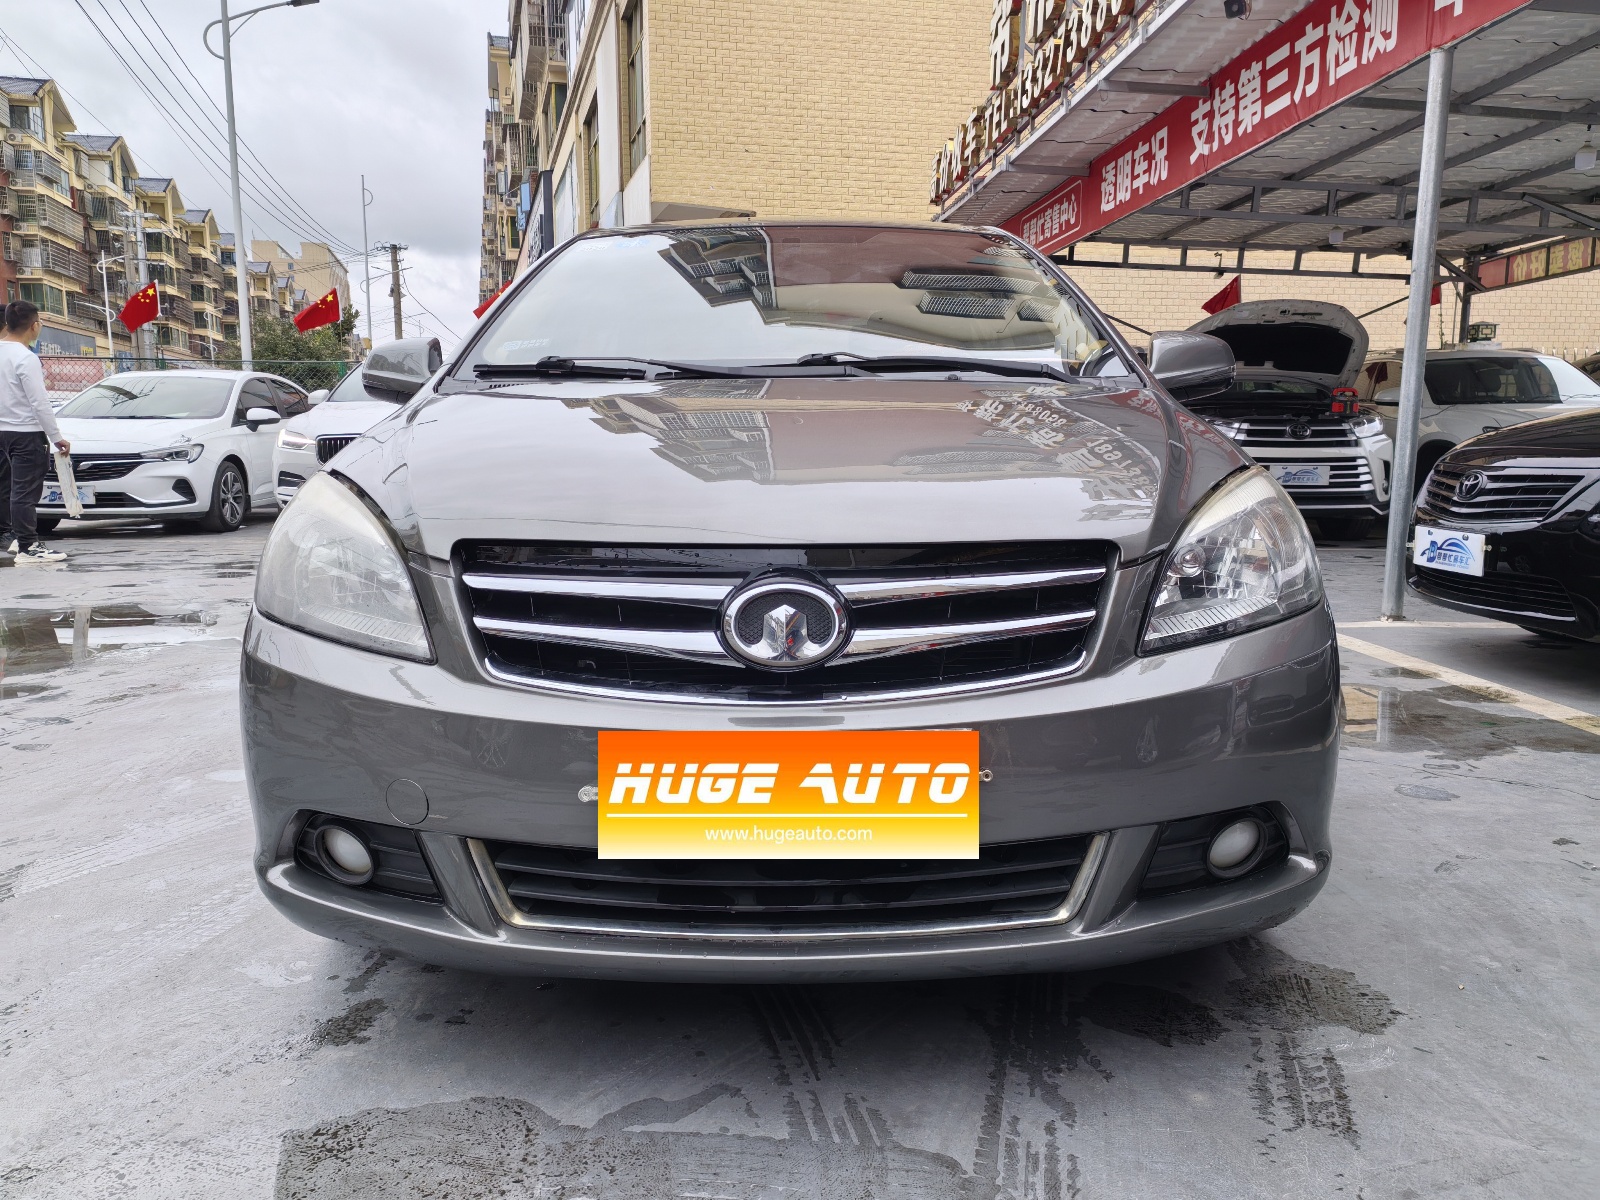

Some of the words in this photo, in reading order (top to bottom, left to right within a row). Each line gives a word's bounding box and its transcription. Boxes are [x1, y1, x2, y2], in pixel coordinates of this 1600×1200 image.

[985, 0, 1122, 149] TEL:13327388
[1100, 126, 1169, 214] 透明车况
[1190, 0, 1399, 165] 支持第三方检测
[1023, 193, 1078, 246] 帮帮忙寄售中心
